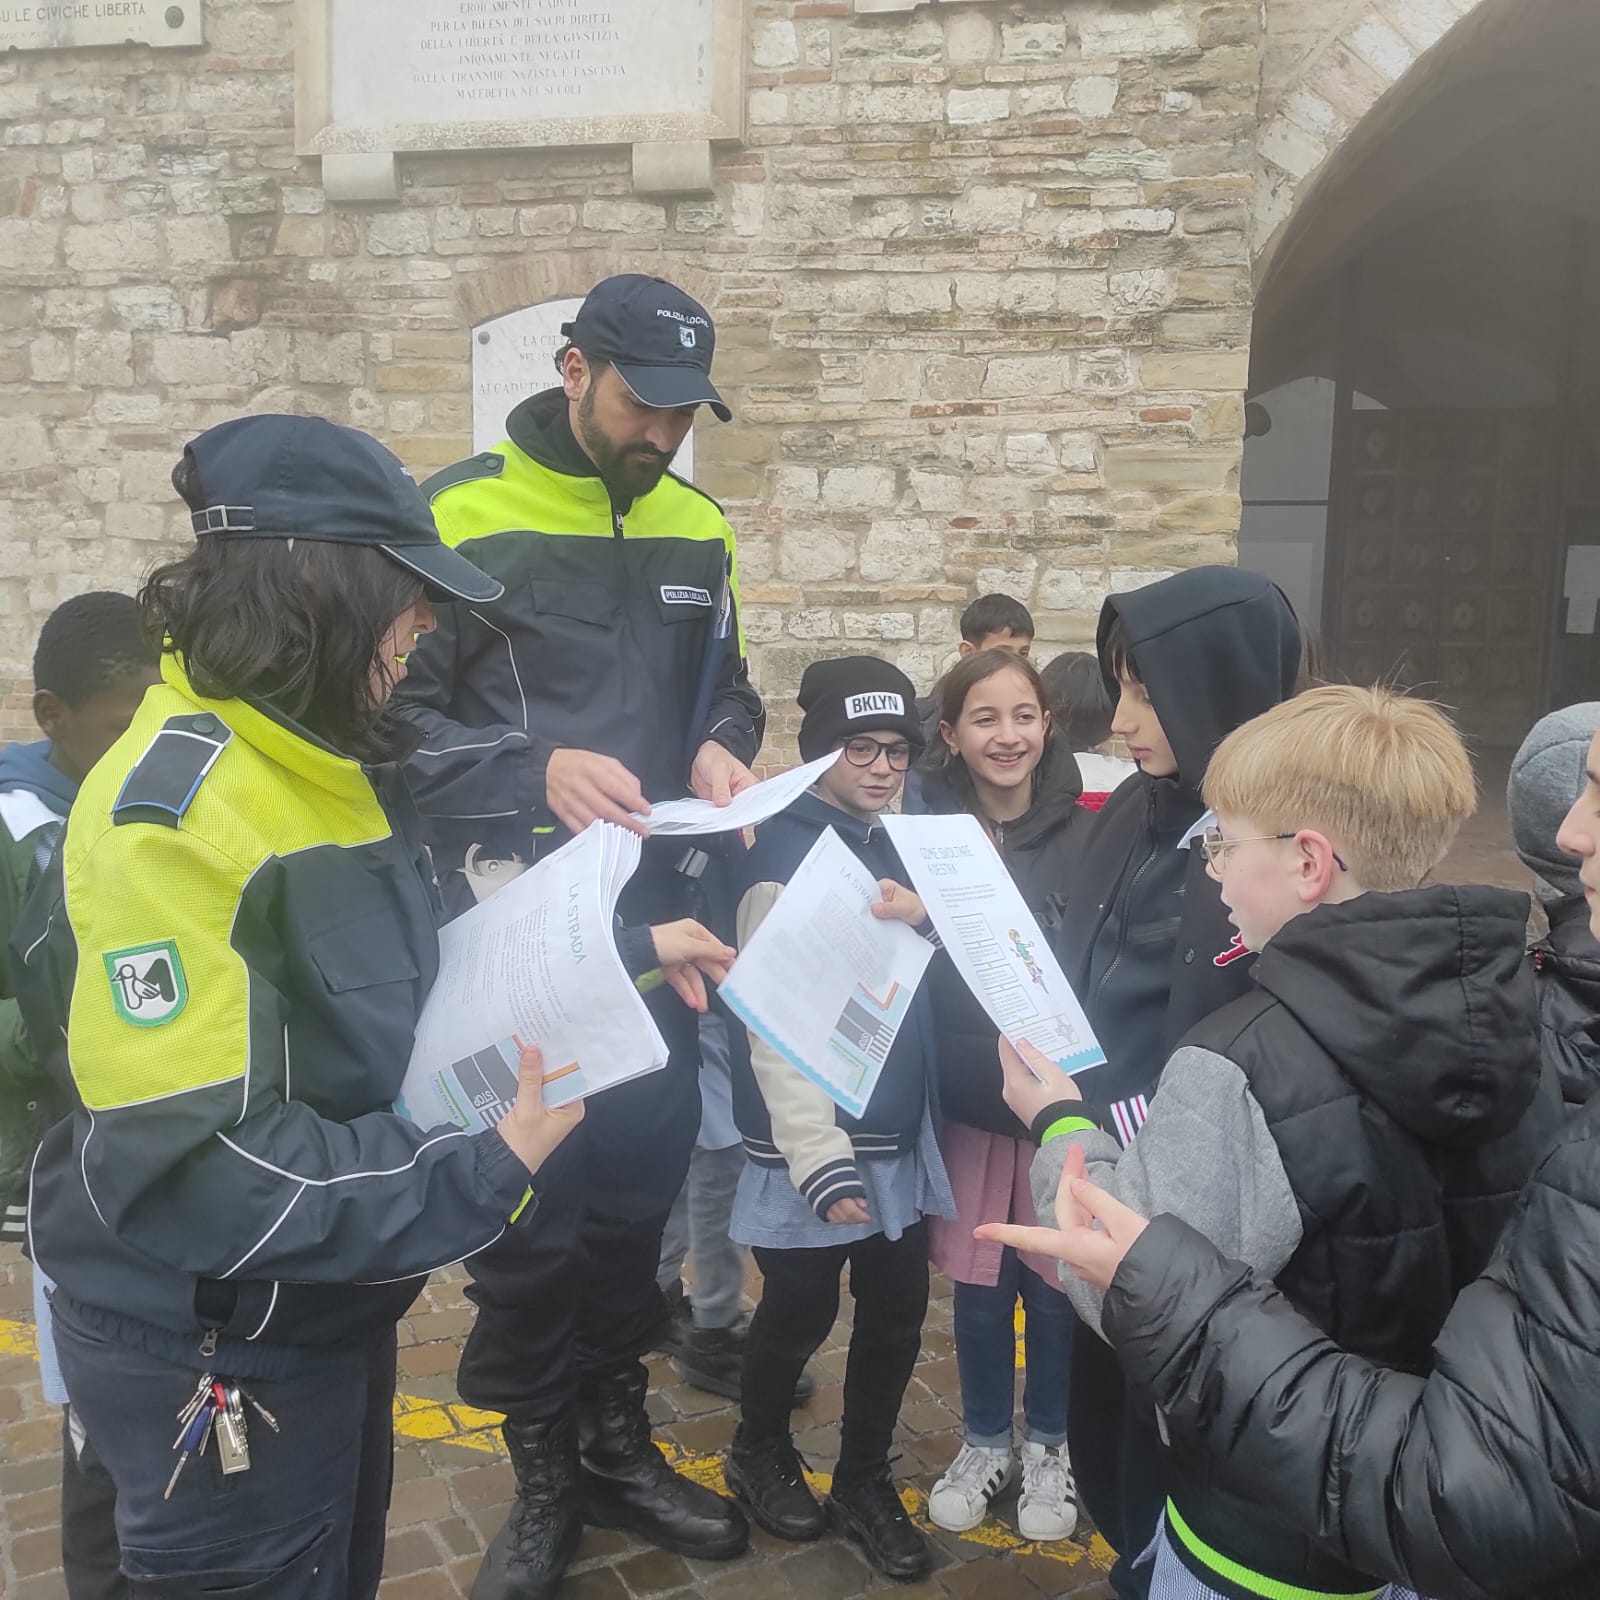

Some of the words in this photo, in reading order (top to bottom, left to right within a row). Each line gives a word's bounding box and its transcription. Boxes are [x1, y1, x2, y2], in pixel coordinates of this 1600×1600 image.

[15, 8, 31, 22] LE
[36, 5, 89, 20] CIVICHE
[431, 20, 450, 32] PER
[453, 20, 467, 31] LA
[472, 18, 509, 30] DIFESA
[513, 17, 530, 28] DEI
[535, 15, 566, 27] SACRI
[570, 13, 612, 25] DIRITTI
[421, 38, 453, 50] DELLA
[524, 32, 560, 45] DELLA
[563, 30, 621, 43] GIVSTIZIA
[539, 49, 582, 62] NEGATI
[413, 72, 446, 84] DALLA
[451, 69, 505, 83] TIRANNIDE
[512, 67, 558, 80] NAZISTA
[574, 64, 627, 78] FASCISTA
[545, 84, 583, 96] SECOLI
[657, 309, 686, 323] POLIZIA
[523, 335, 537, 346] LA
[665, 590, 690, 600] POLIZIA
[852, 695, 899, 714] BKLYN
[568, 882, 580, 904] LA
[567, 906, 587, 965] STRADA
[473, 1090, 494, 1107] STOP
